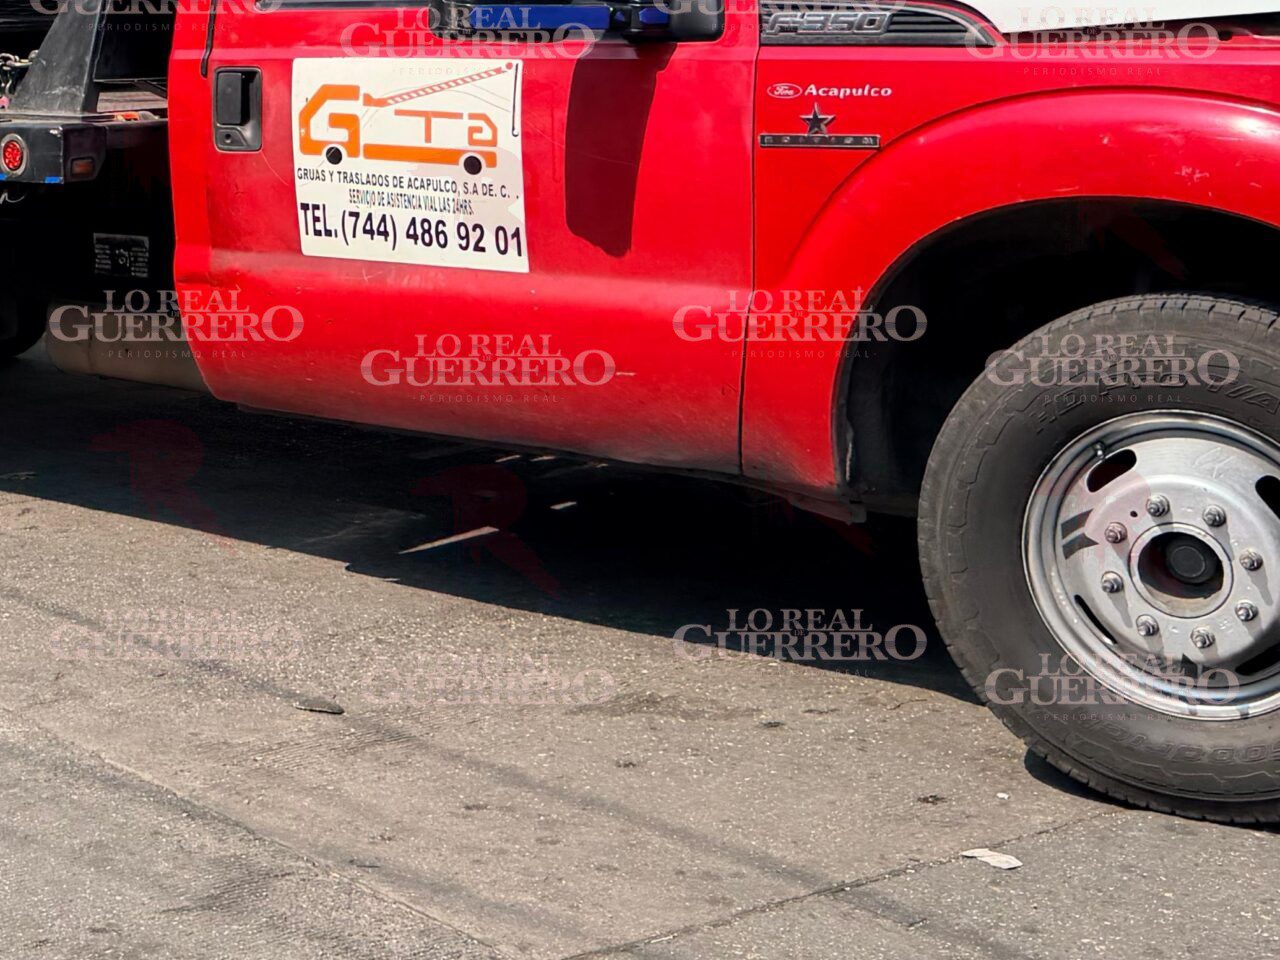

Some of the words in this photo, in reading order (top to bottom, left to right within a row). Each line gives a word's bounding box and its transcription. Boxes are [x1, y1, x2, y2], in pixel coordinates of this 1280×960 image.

[804, 84, 892, 99] Acapulco
[297, 167, 326, 182] GRUAS
[328, 170, 334, 183] Y
[337, 170, 389, 188] TRASLADOS
[392, 176, 404, 189] DE
[407, 177, 460, 196] ACAPULCO,
[377, 191, 385, 208] DE
[386, 191, 422, 211] ASISTENCIA
[439, 196, 451, 214] LAS
[405, 216, 448, 249] 486
[456, 221, 486, 253] 92
[494, 225, 523, 257] 01
